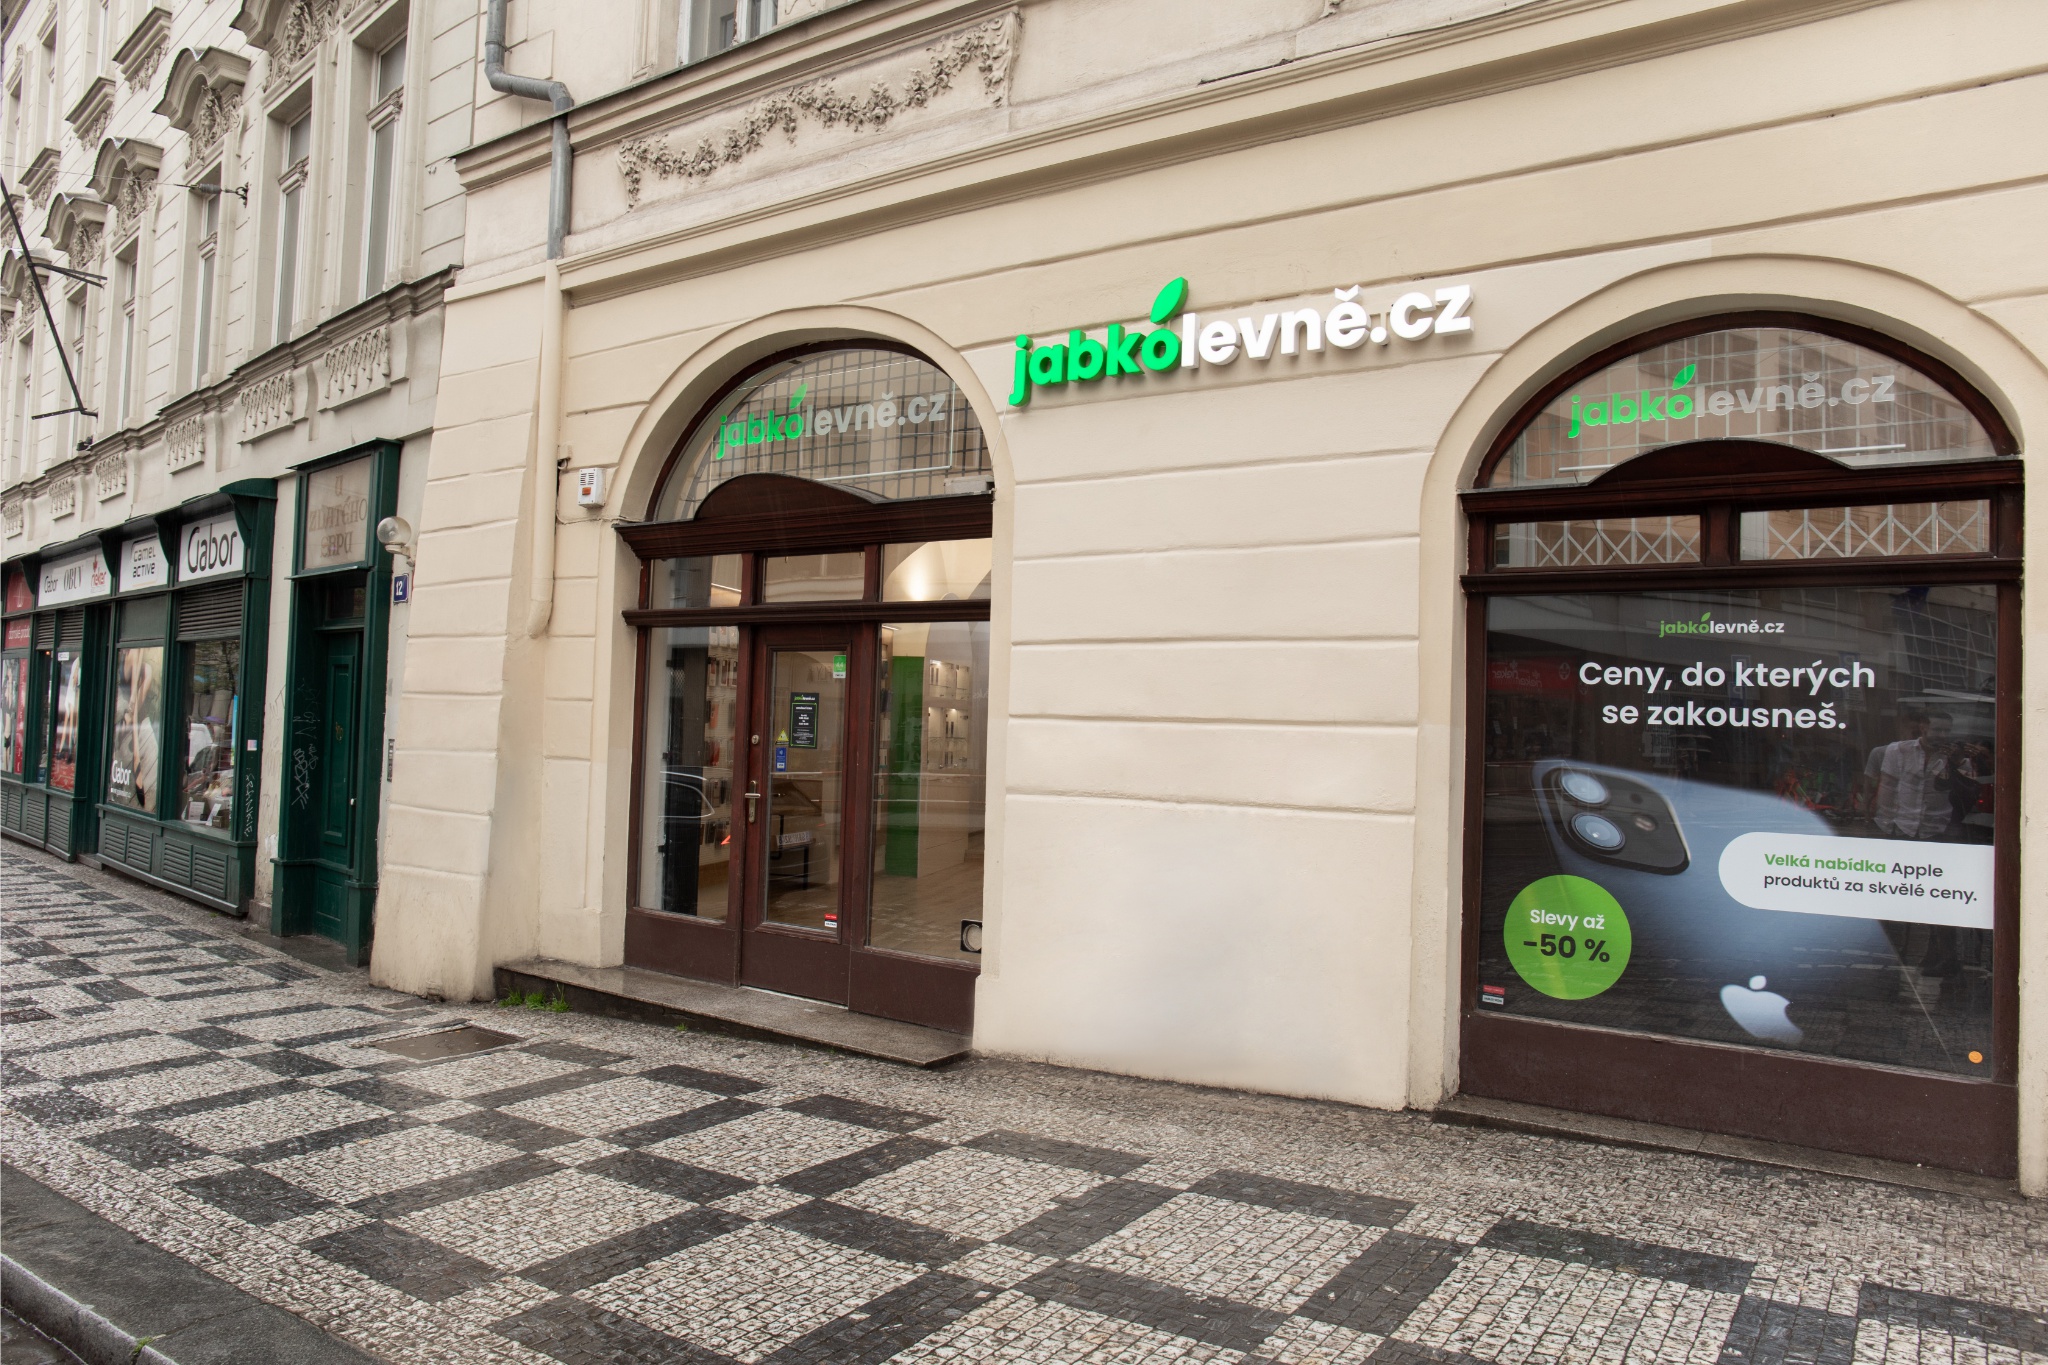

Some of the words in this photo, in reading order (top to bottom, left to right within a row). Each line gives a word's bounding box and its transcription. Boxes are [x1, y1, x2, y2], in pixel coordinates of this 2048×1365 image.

[188, 523, 238, 574] Gabor
[44, 576, 59, 593] Gabor
[63, 566, 83, 592] OBUV
[395, 580, 403, 596] 12
[1579, 662, 1673, 694] Ceny,
[1681, 662, 1726, 687] do
[1735, 660, 1875, 696] kterých
[1602, 704, 1639, 725] se
[1647, 701, 1847, 730] zakousneš.
[111, 760, 132, 785] Gabor
[1764, 853, 1810, 868] Velká
[1814, 857, 1886, 873] nabídka
[1891, 862, 1943, 879] Apple
[1764, 875, 1840, 890] produktů
[1844, 880, 1864, 892] za
[1869, 881, 1925, 897] skvělé
[1930, 886, 1977, 905] ceny.
[1530, 909, 1579, 931] Slevy
[1583, 914, 1605, 930] až
[1523, 933, 1576, 959] -50
[1584, 938, 1611, 963] %
